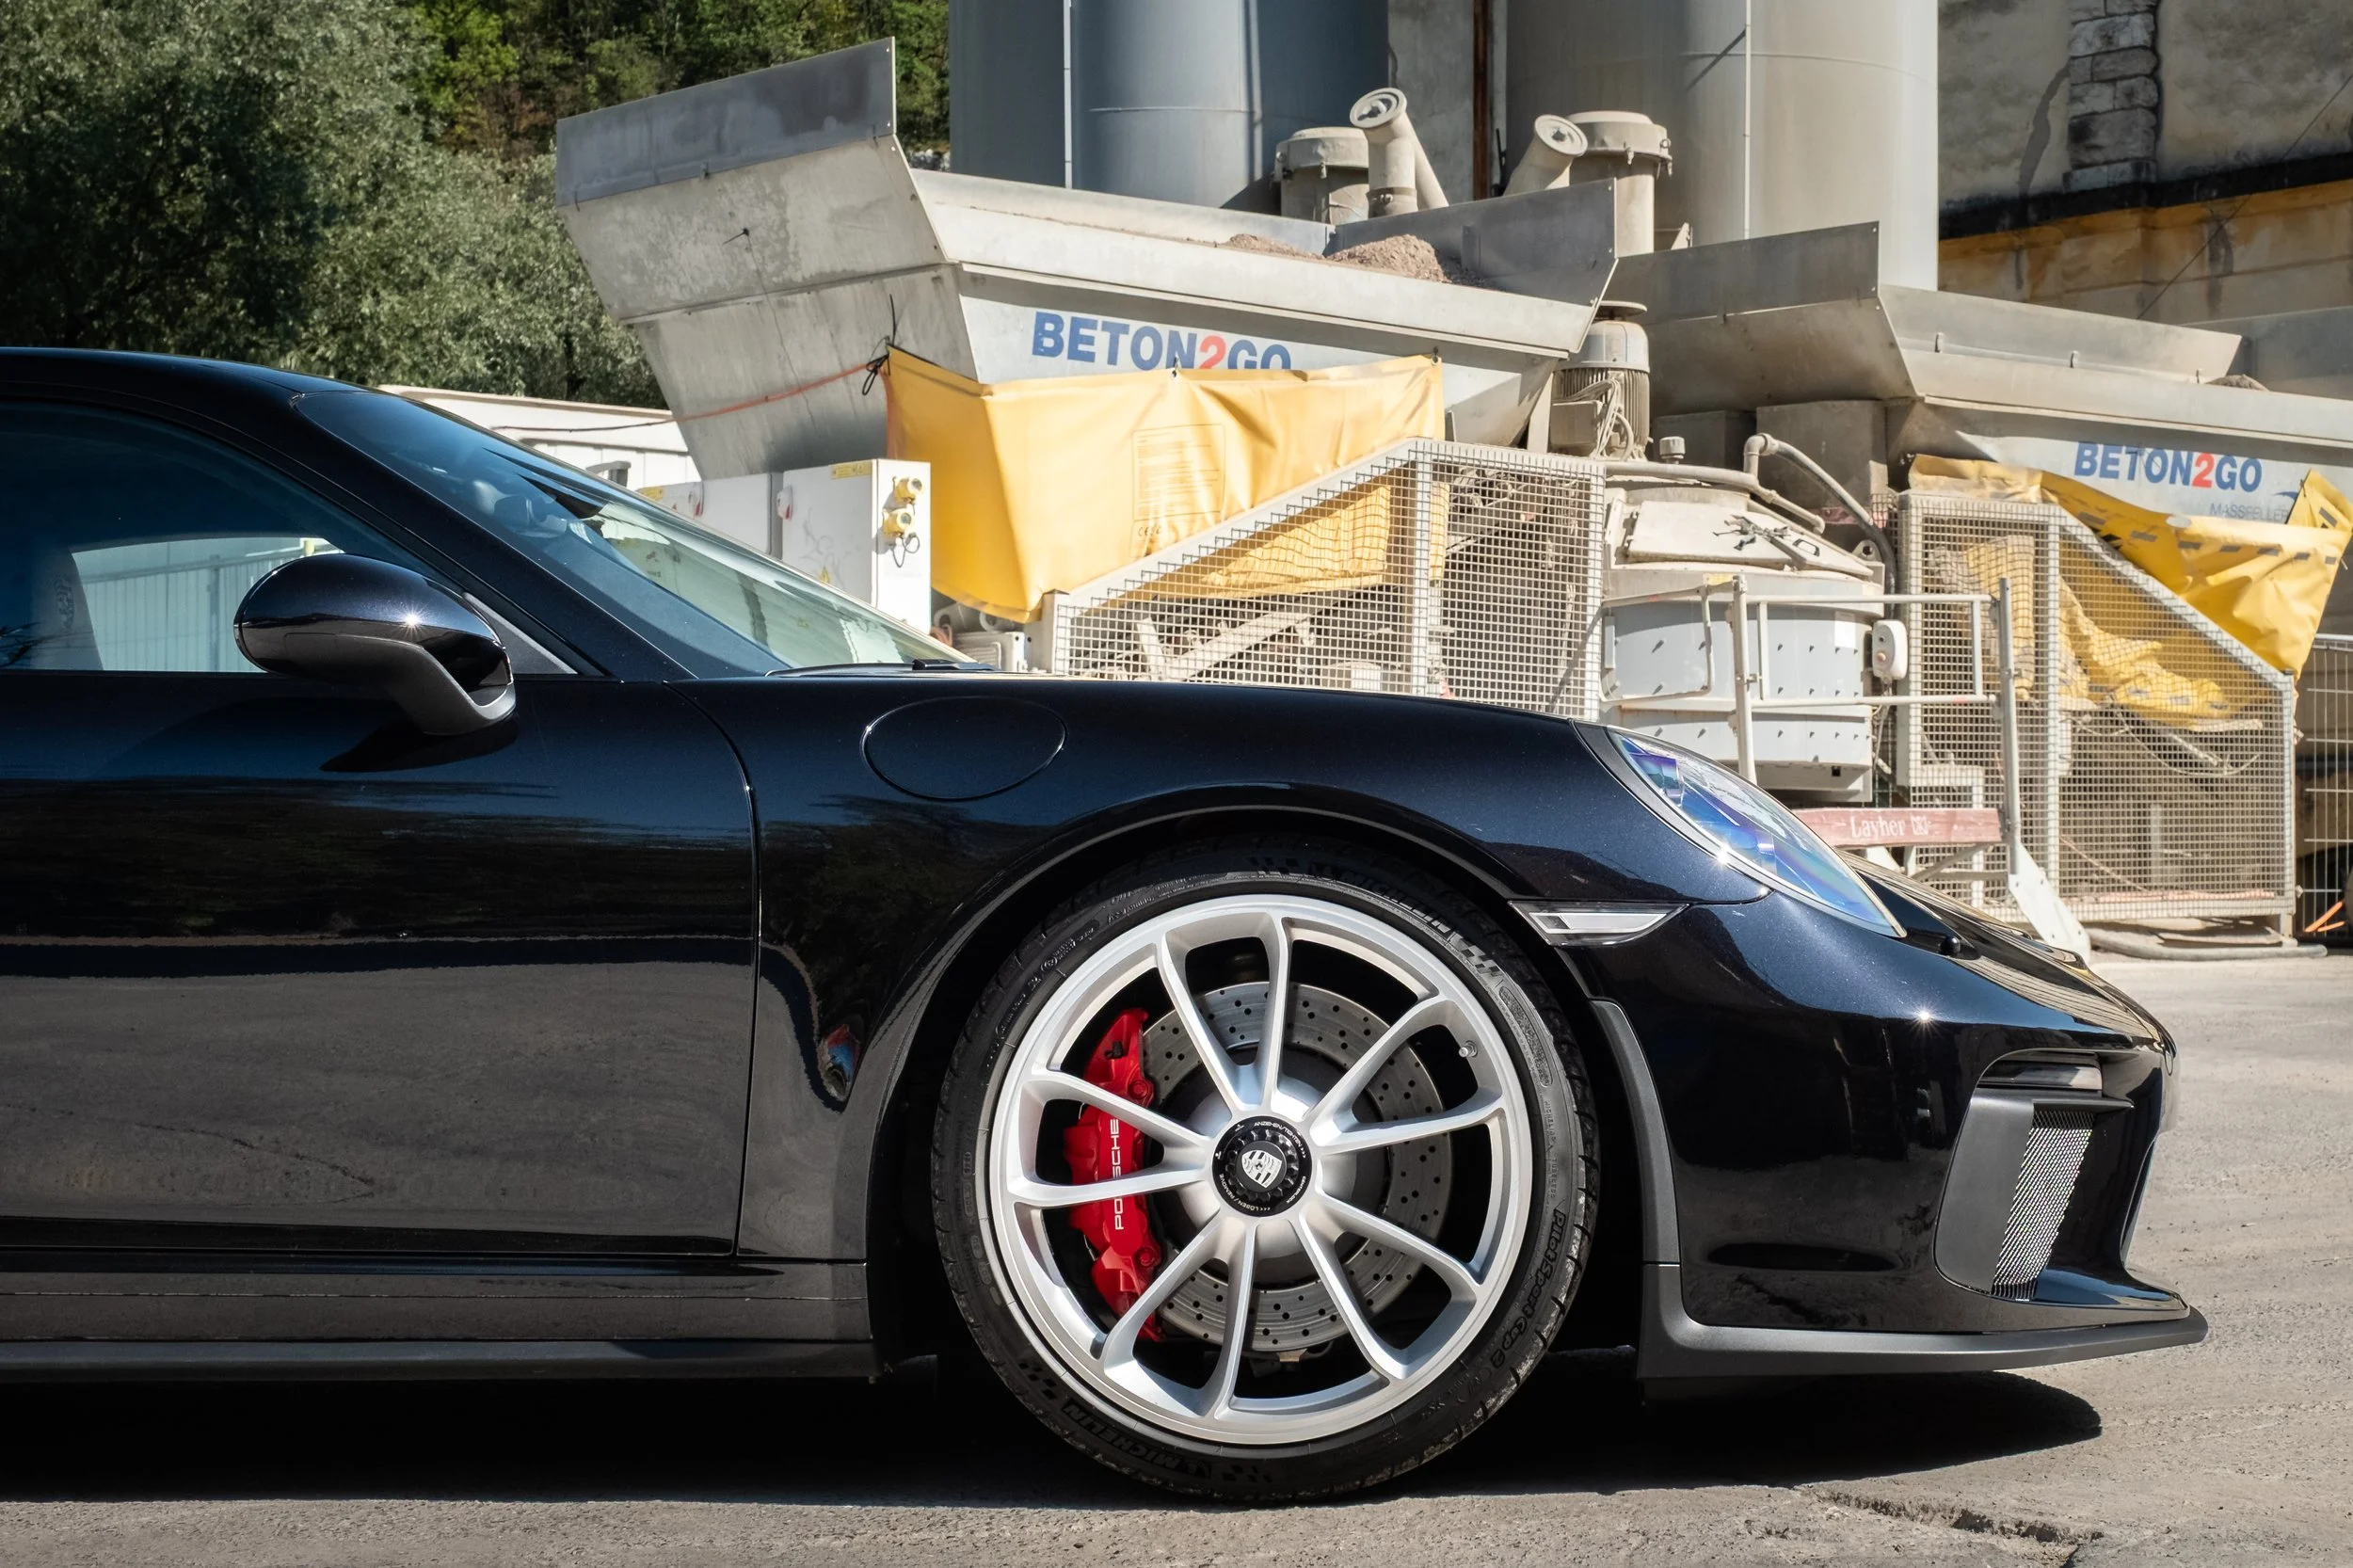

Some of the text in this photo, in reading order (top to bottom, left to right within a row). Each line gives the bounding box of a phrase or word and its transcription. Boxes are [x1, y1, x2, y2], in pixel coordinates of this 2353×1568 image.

[1032, 312, 1291, 370] BETON2GO
[2074, 441, 2263, 492] BETON2GO
[1850, 816, 1906, 838] Layher
[1110, 1119, 1124, 1230] POSCHE
[1544, 1208, 1566, 1264] Pilot
[1522, 1260, 1553, 1318] Sport
[1501, 1315, 1528, 1350] Cup
[1064, 1403, 1181, 1469] MICHELIN
